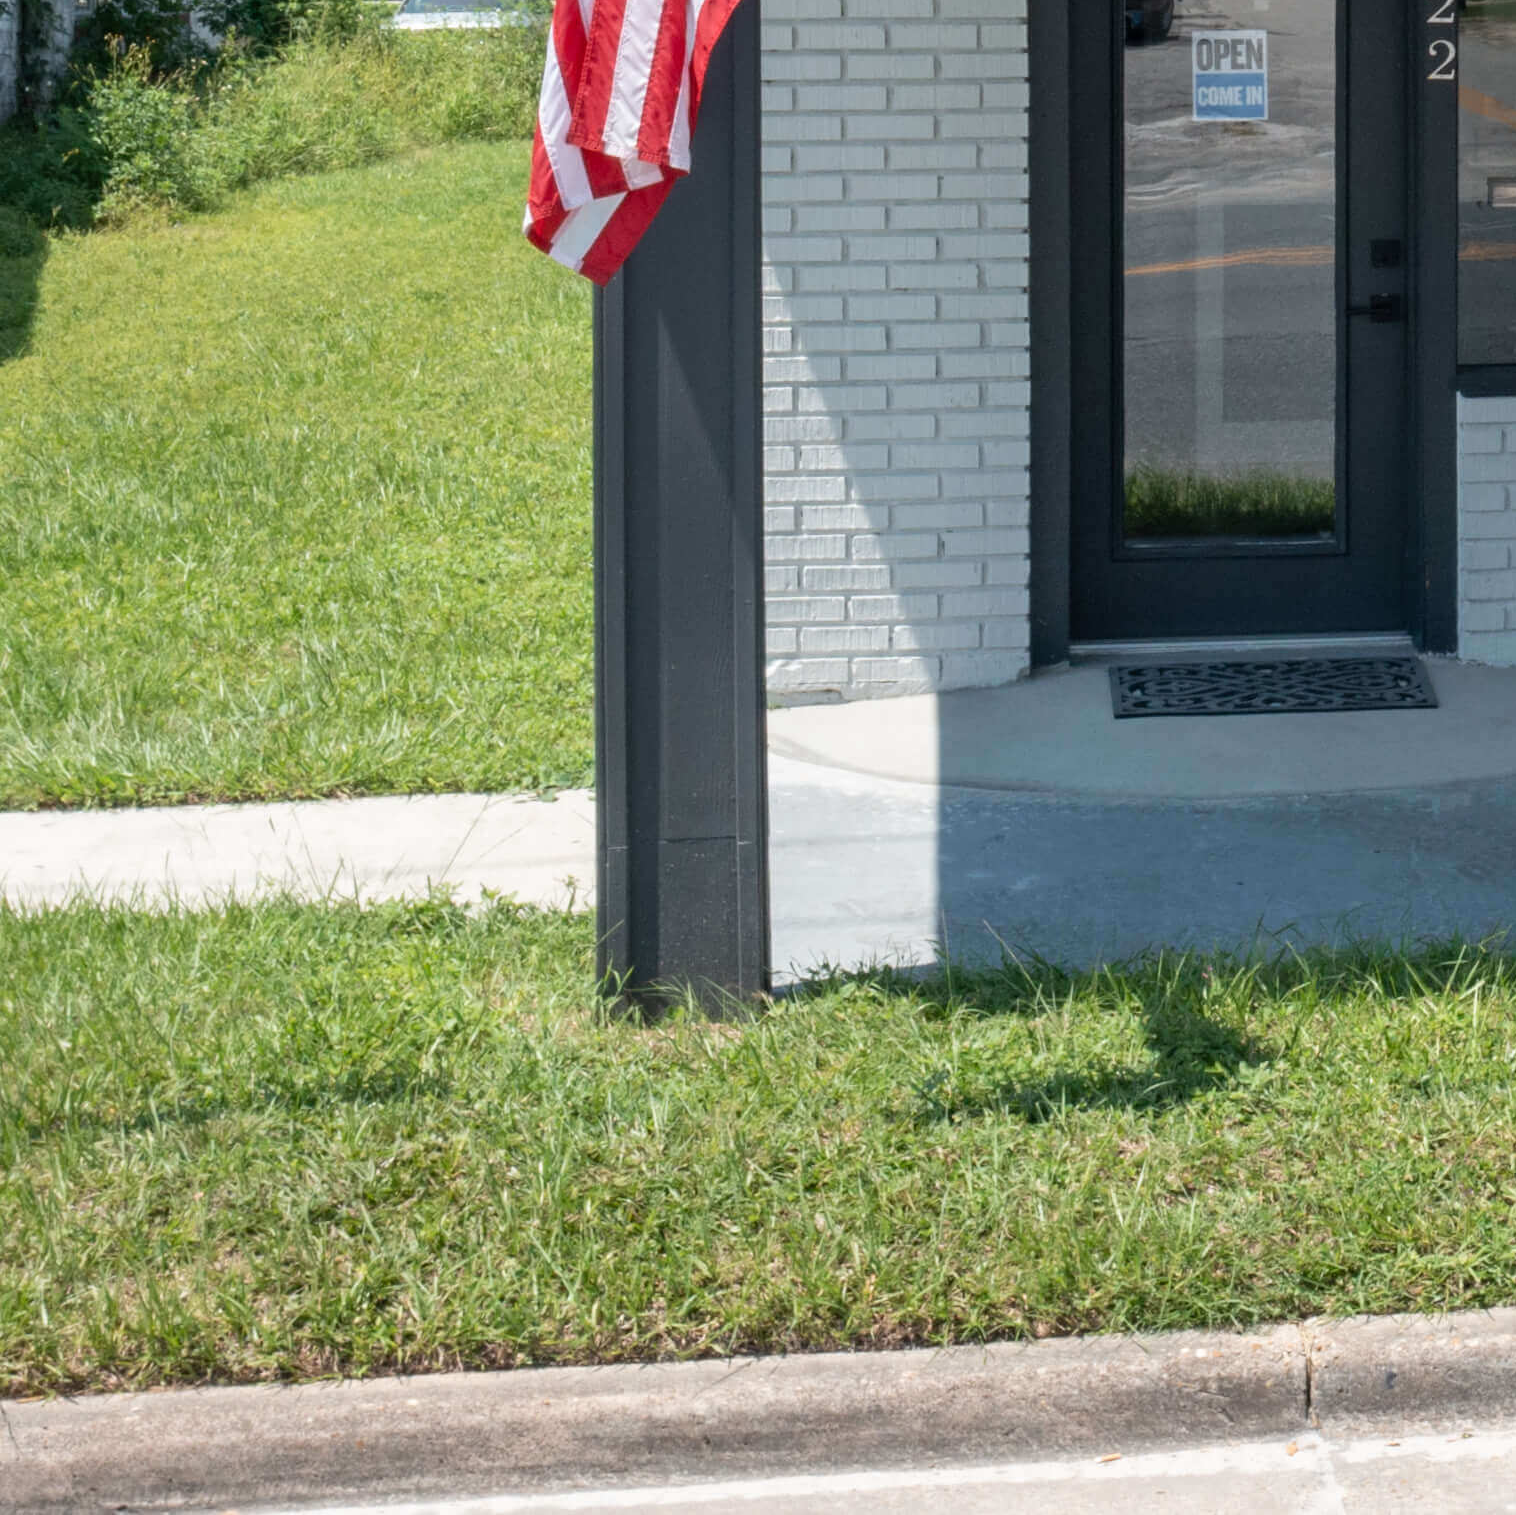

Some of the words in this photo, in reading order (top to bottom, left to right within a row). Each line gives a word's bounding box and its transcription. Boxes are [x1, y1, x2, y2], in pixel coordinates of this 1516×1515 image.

[1196, 38, 1264, 71] OPEN
[1197, 85, 1243, 106] COME
[1246, 85, 1264, 106] IN
